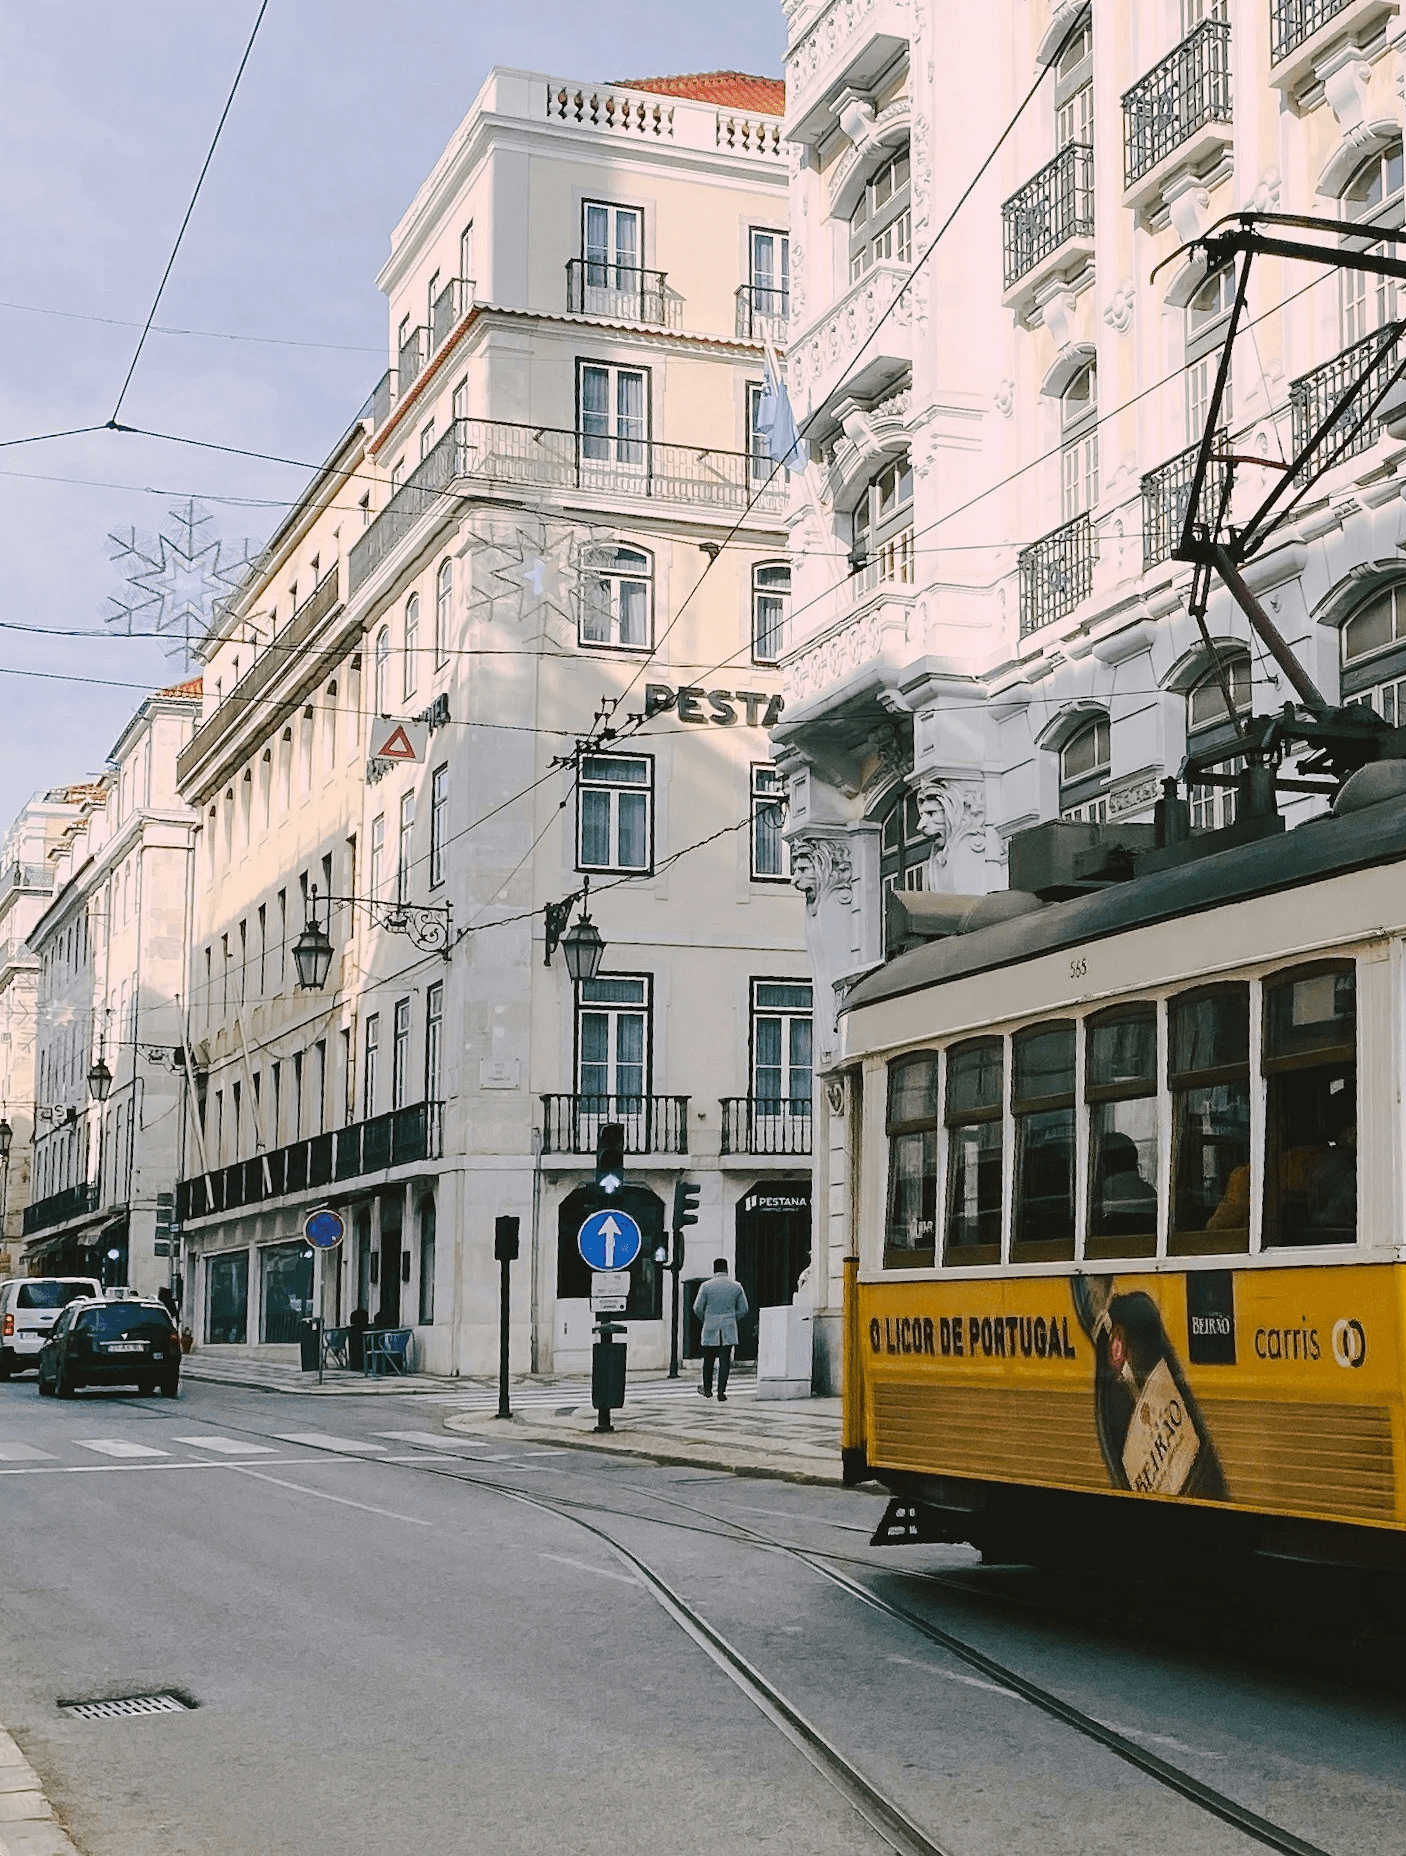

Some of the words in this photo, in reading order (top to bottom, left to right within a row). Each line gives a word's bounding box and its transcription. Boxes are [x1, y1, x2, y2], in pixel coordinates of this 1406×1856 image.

[1070, 957, 1087, 978] 565
[759, 1197, 807, 1206] PESTANA
[870, 1316, 881, 1354] O
[885, 1316, 935, 1357] LICOR
[940, 1316, 965, 1357] DE
[969, 1316, 1076, 1360] PORTUGAL
[1255, 1314, 1322, 1361] carris
